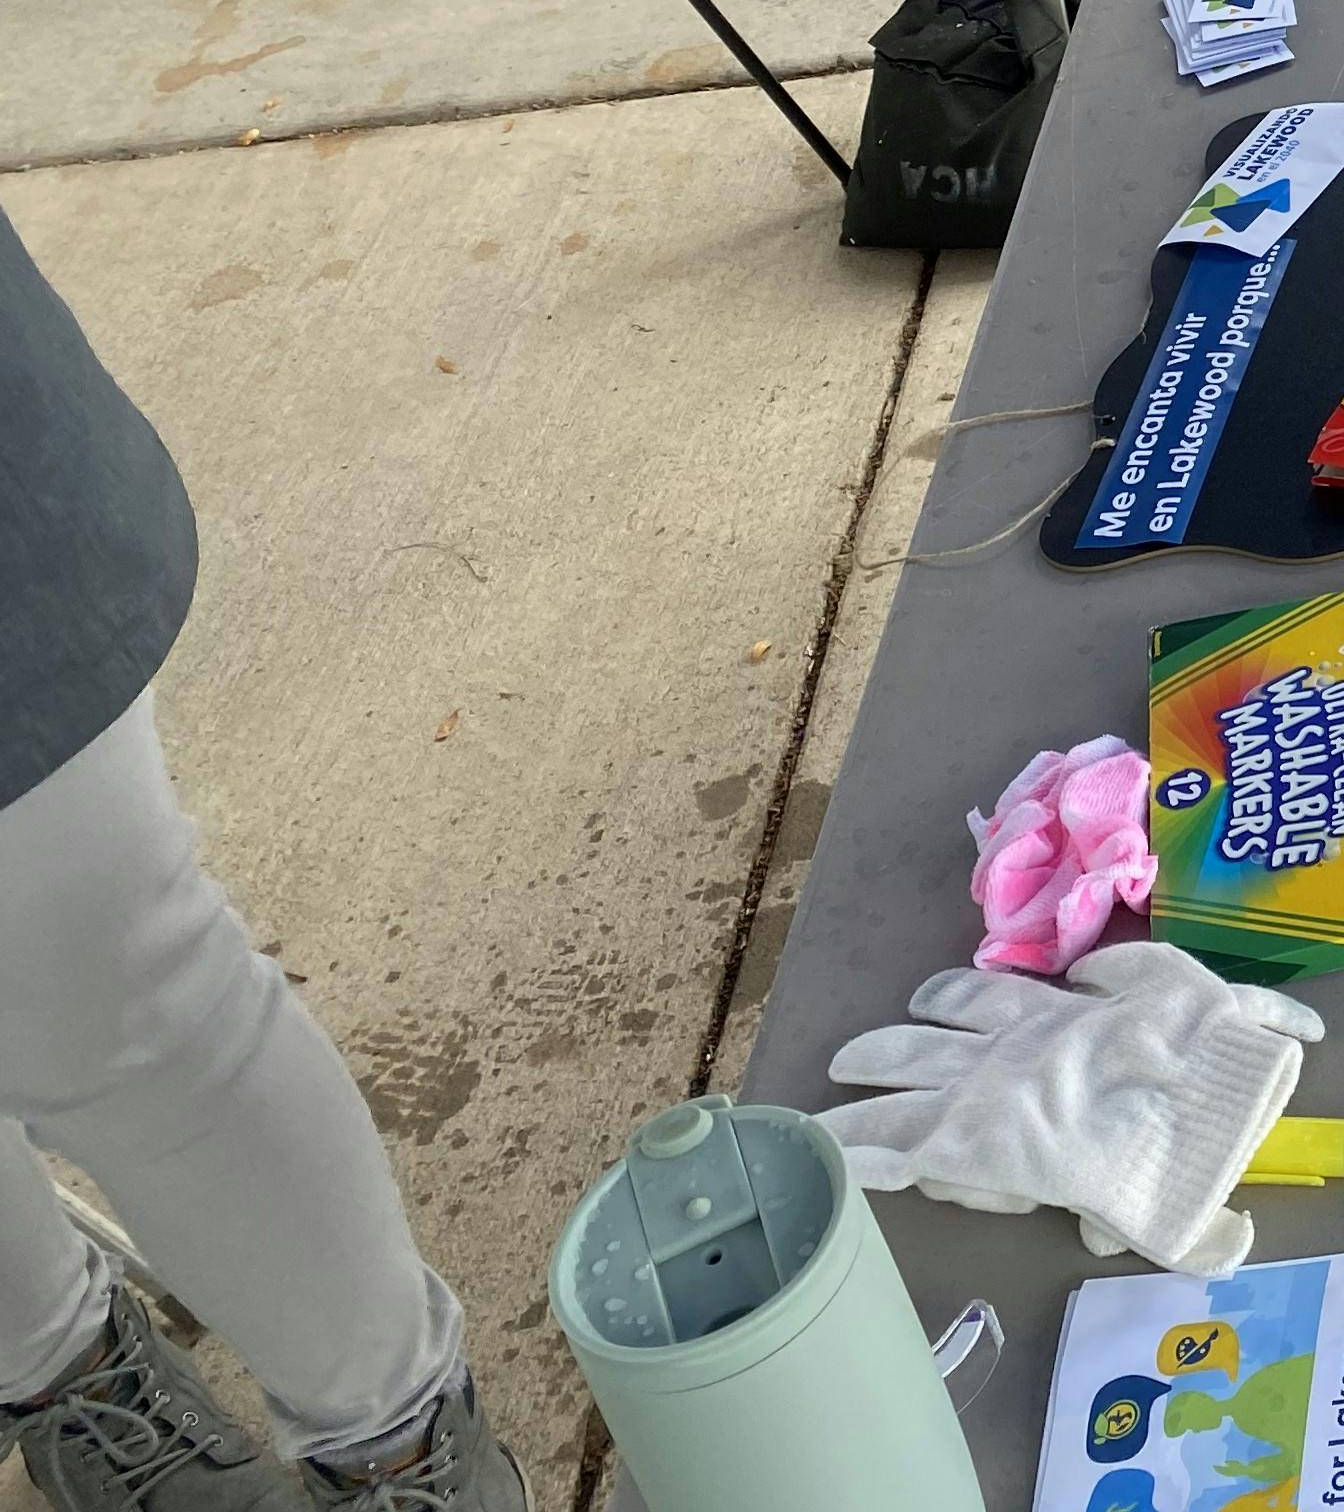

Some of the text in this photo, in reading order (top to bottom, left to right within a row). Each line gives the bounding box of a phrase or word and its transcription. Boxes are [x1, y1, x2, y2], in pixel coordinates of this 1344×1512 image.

[1223, 107, 1298, 178] VISUALIZANDO
[1237, 107, 1315, 181] LAKEWOOD
[1257, 139, 1301, 183] en el 2040
[1093, 311, 1208, 538] Me encanta vivir
[1148, 243, 1281, 533] en Lakewood porque...
[1167, 772, 1202, 804] 12
[1219, 702, 1272, 861] MARKERS
[1267, 669, 1325, 869] WASHABLE
